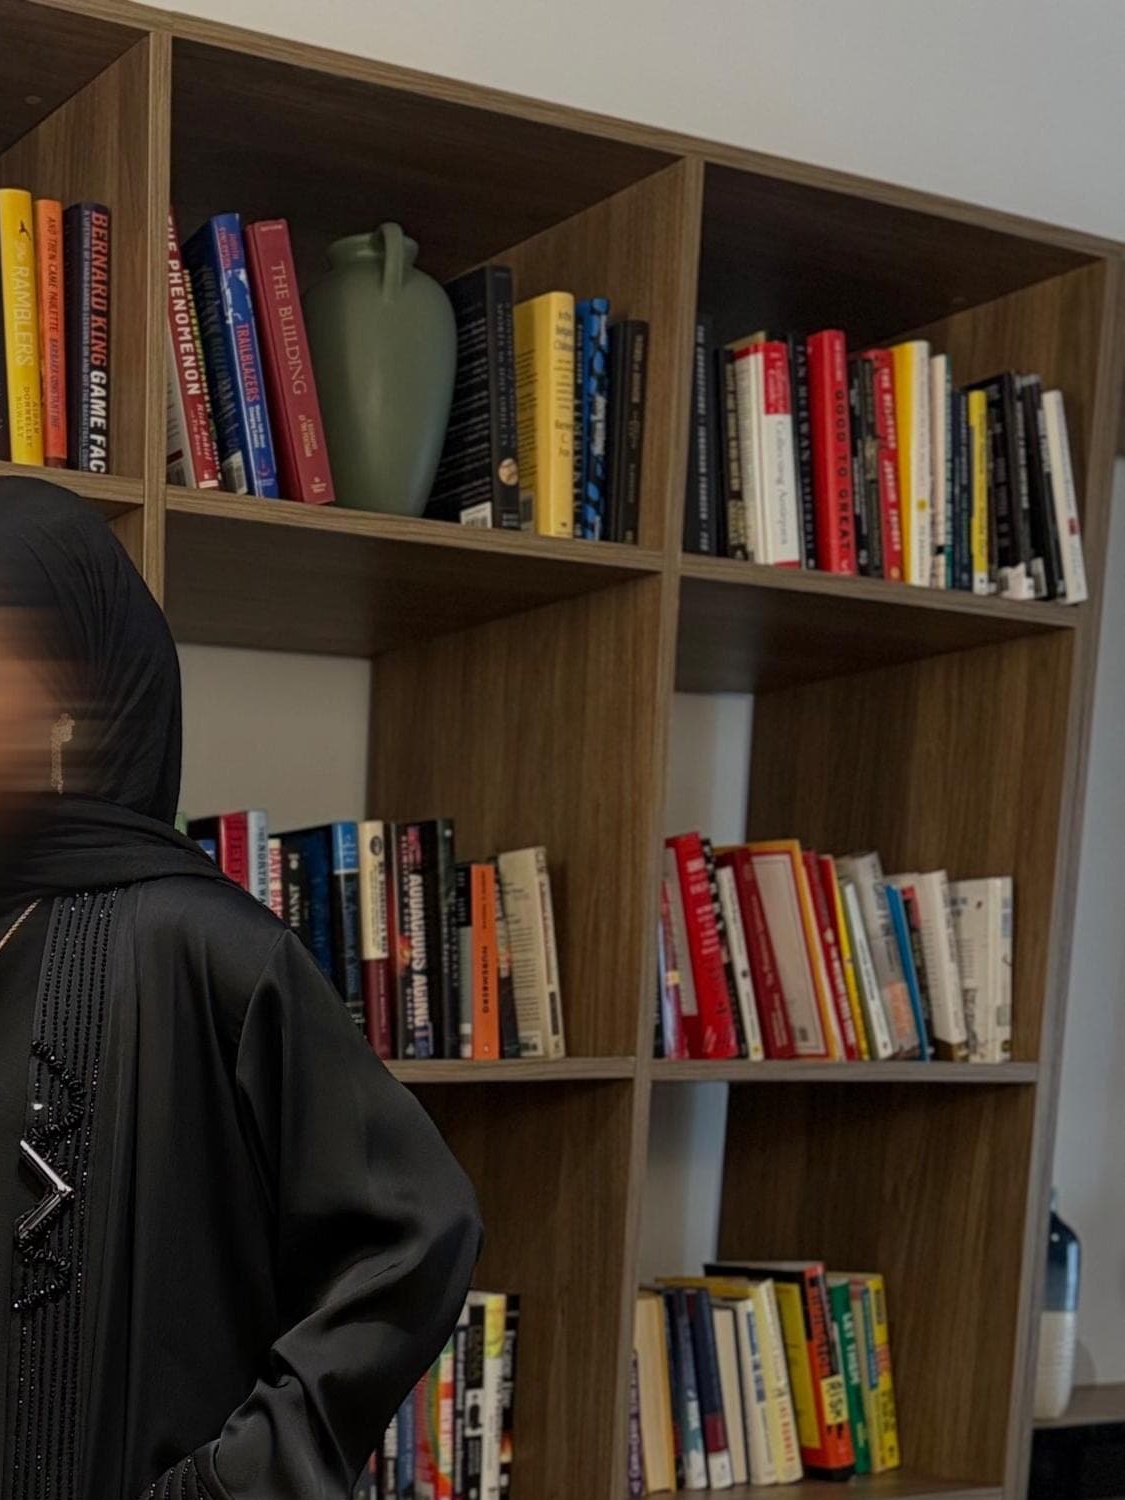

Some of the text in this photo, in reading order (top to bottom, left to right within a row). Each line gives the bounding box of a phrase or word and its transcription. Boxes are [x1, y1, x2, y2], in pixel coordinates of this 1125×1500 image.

[10, 265, 32, 367] RAMBLERS
[89, 211, 108, 472] BERNARD KING GAME FAC
[167, 259, 198, 395] PHENOMENON
[235, 323, 259, 402] TRAILBLAZERS
[269, 260, 308, 395] THE BUILDING
[834, 390, 850, 549] GOOD TO GREAT
[406, 873, 427, 970] AUDACIOUS
[411, 973, 430, 1026] AGING
[481, 945, 489, 1013] NUREMBERG
